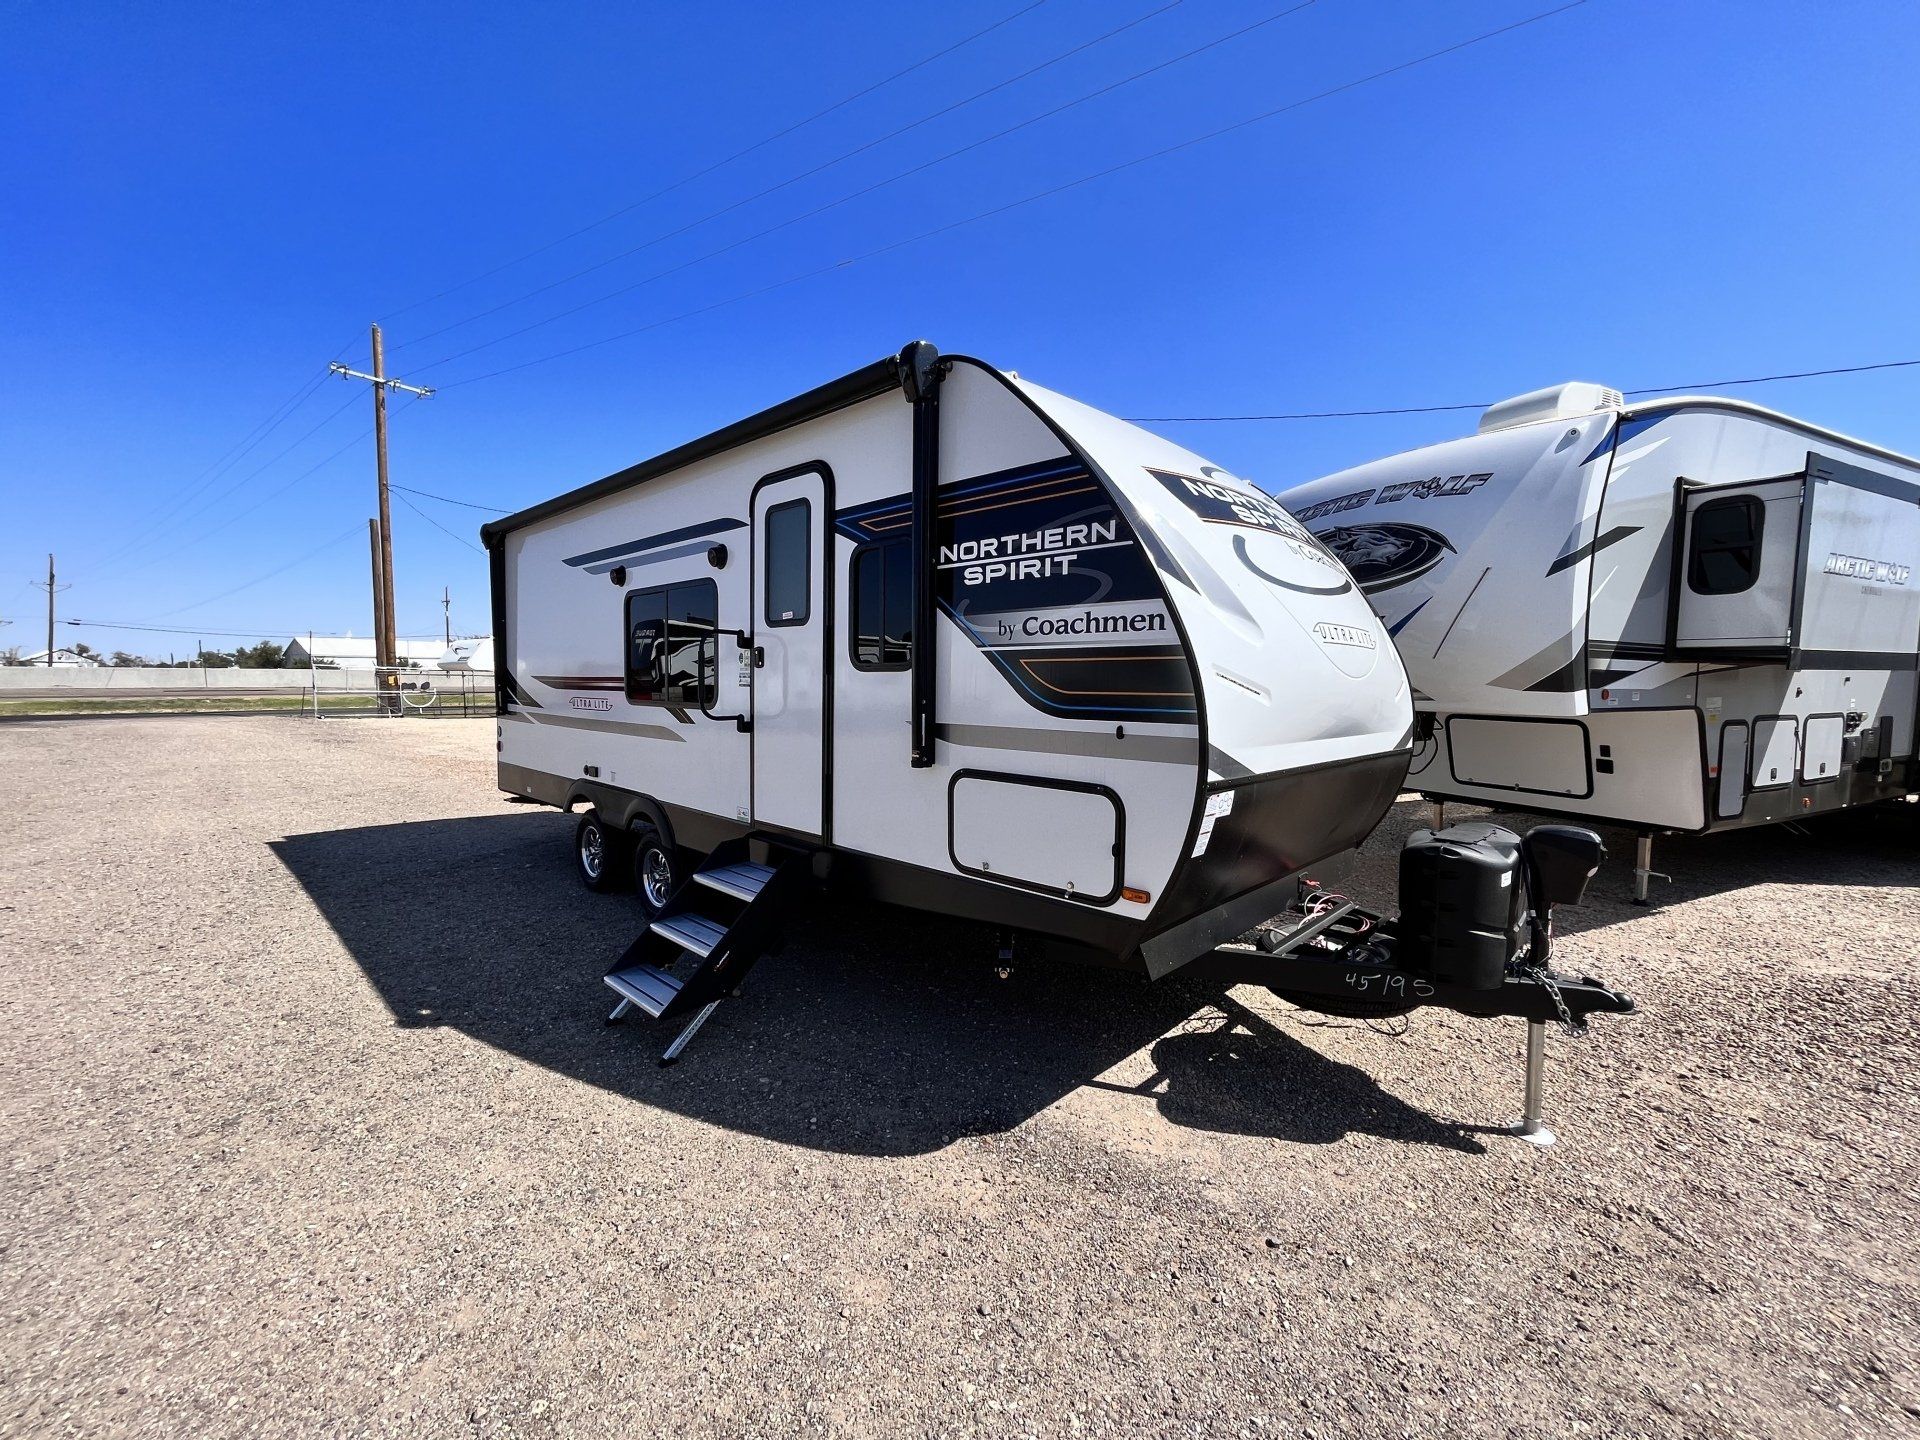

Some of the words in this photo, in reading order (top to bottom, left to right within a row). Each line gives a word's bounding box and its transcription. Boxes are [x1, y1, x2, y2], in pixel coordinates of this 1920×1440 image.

[1293, 488, 1376, 523] RCTIC
[940, 520, 1116, 563] NORTHERN
[963, 554, 1077, 586] SPIRIT
[1823, 552, 1876, 580] ARCTIC
[998, 620, 1016, 641] by
[1022, 611, 1167, 637] Coachmen
[1319, 625, 1355, 642] ULTRA
[572, 699, 592, 708] ULTRA
[594, 700, 609, 710] LITE
